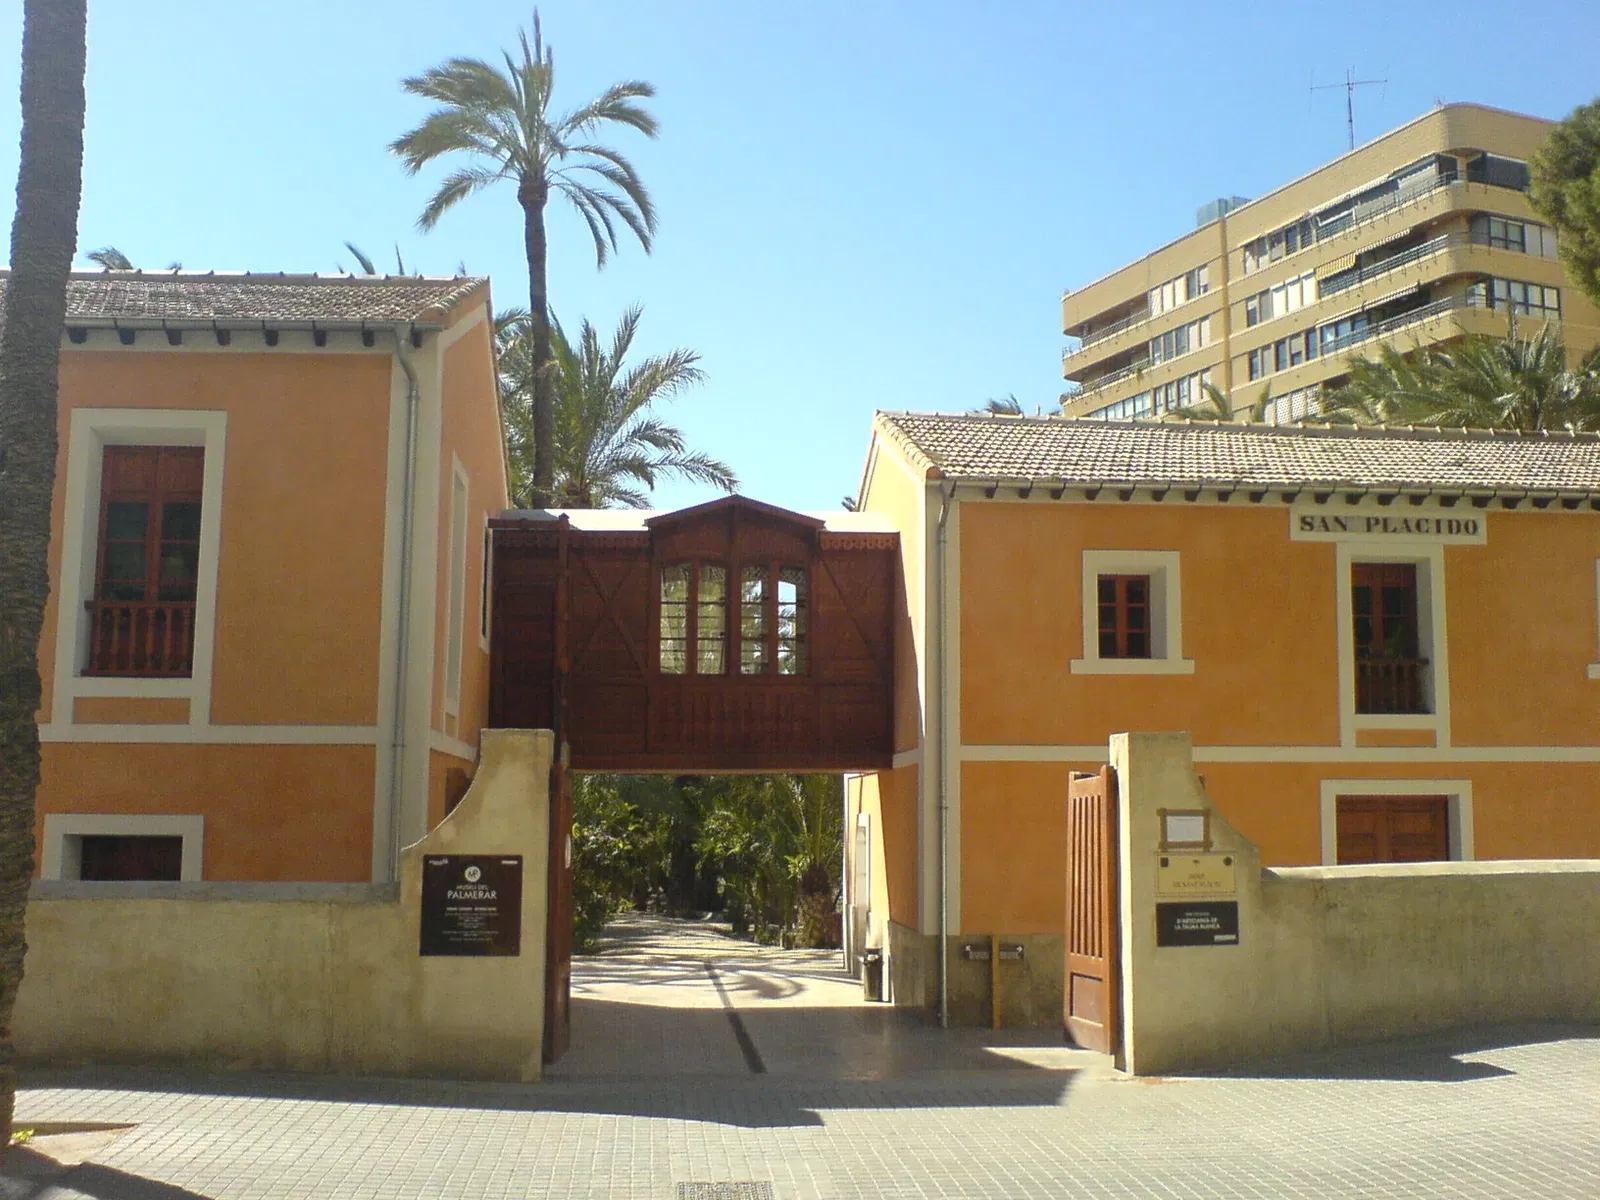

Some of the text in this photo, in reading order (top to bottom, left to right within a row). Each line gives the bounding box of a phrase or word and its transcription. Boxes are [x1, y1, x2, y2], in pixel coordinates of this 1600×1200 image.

[1299, 515, 1479, 535] SAN PLACIDO
[446, 890, 498, 900] PALMERAR
